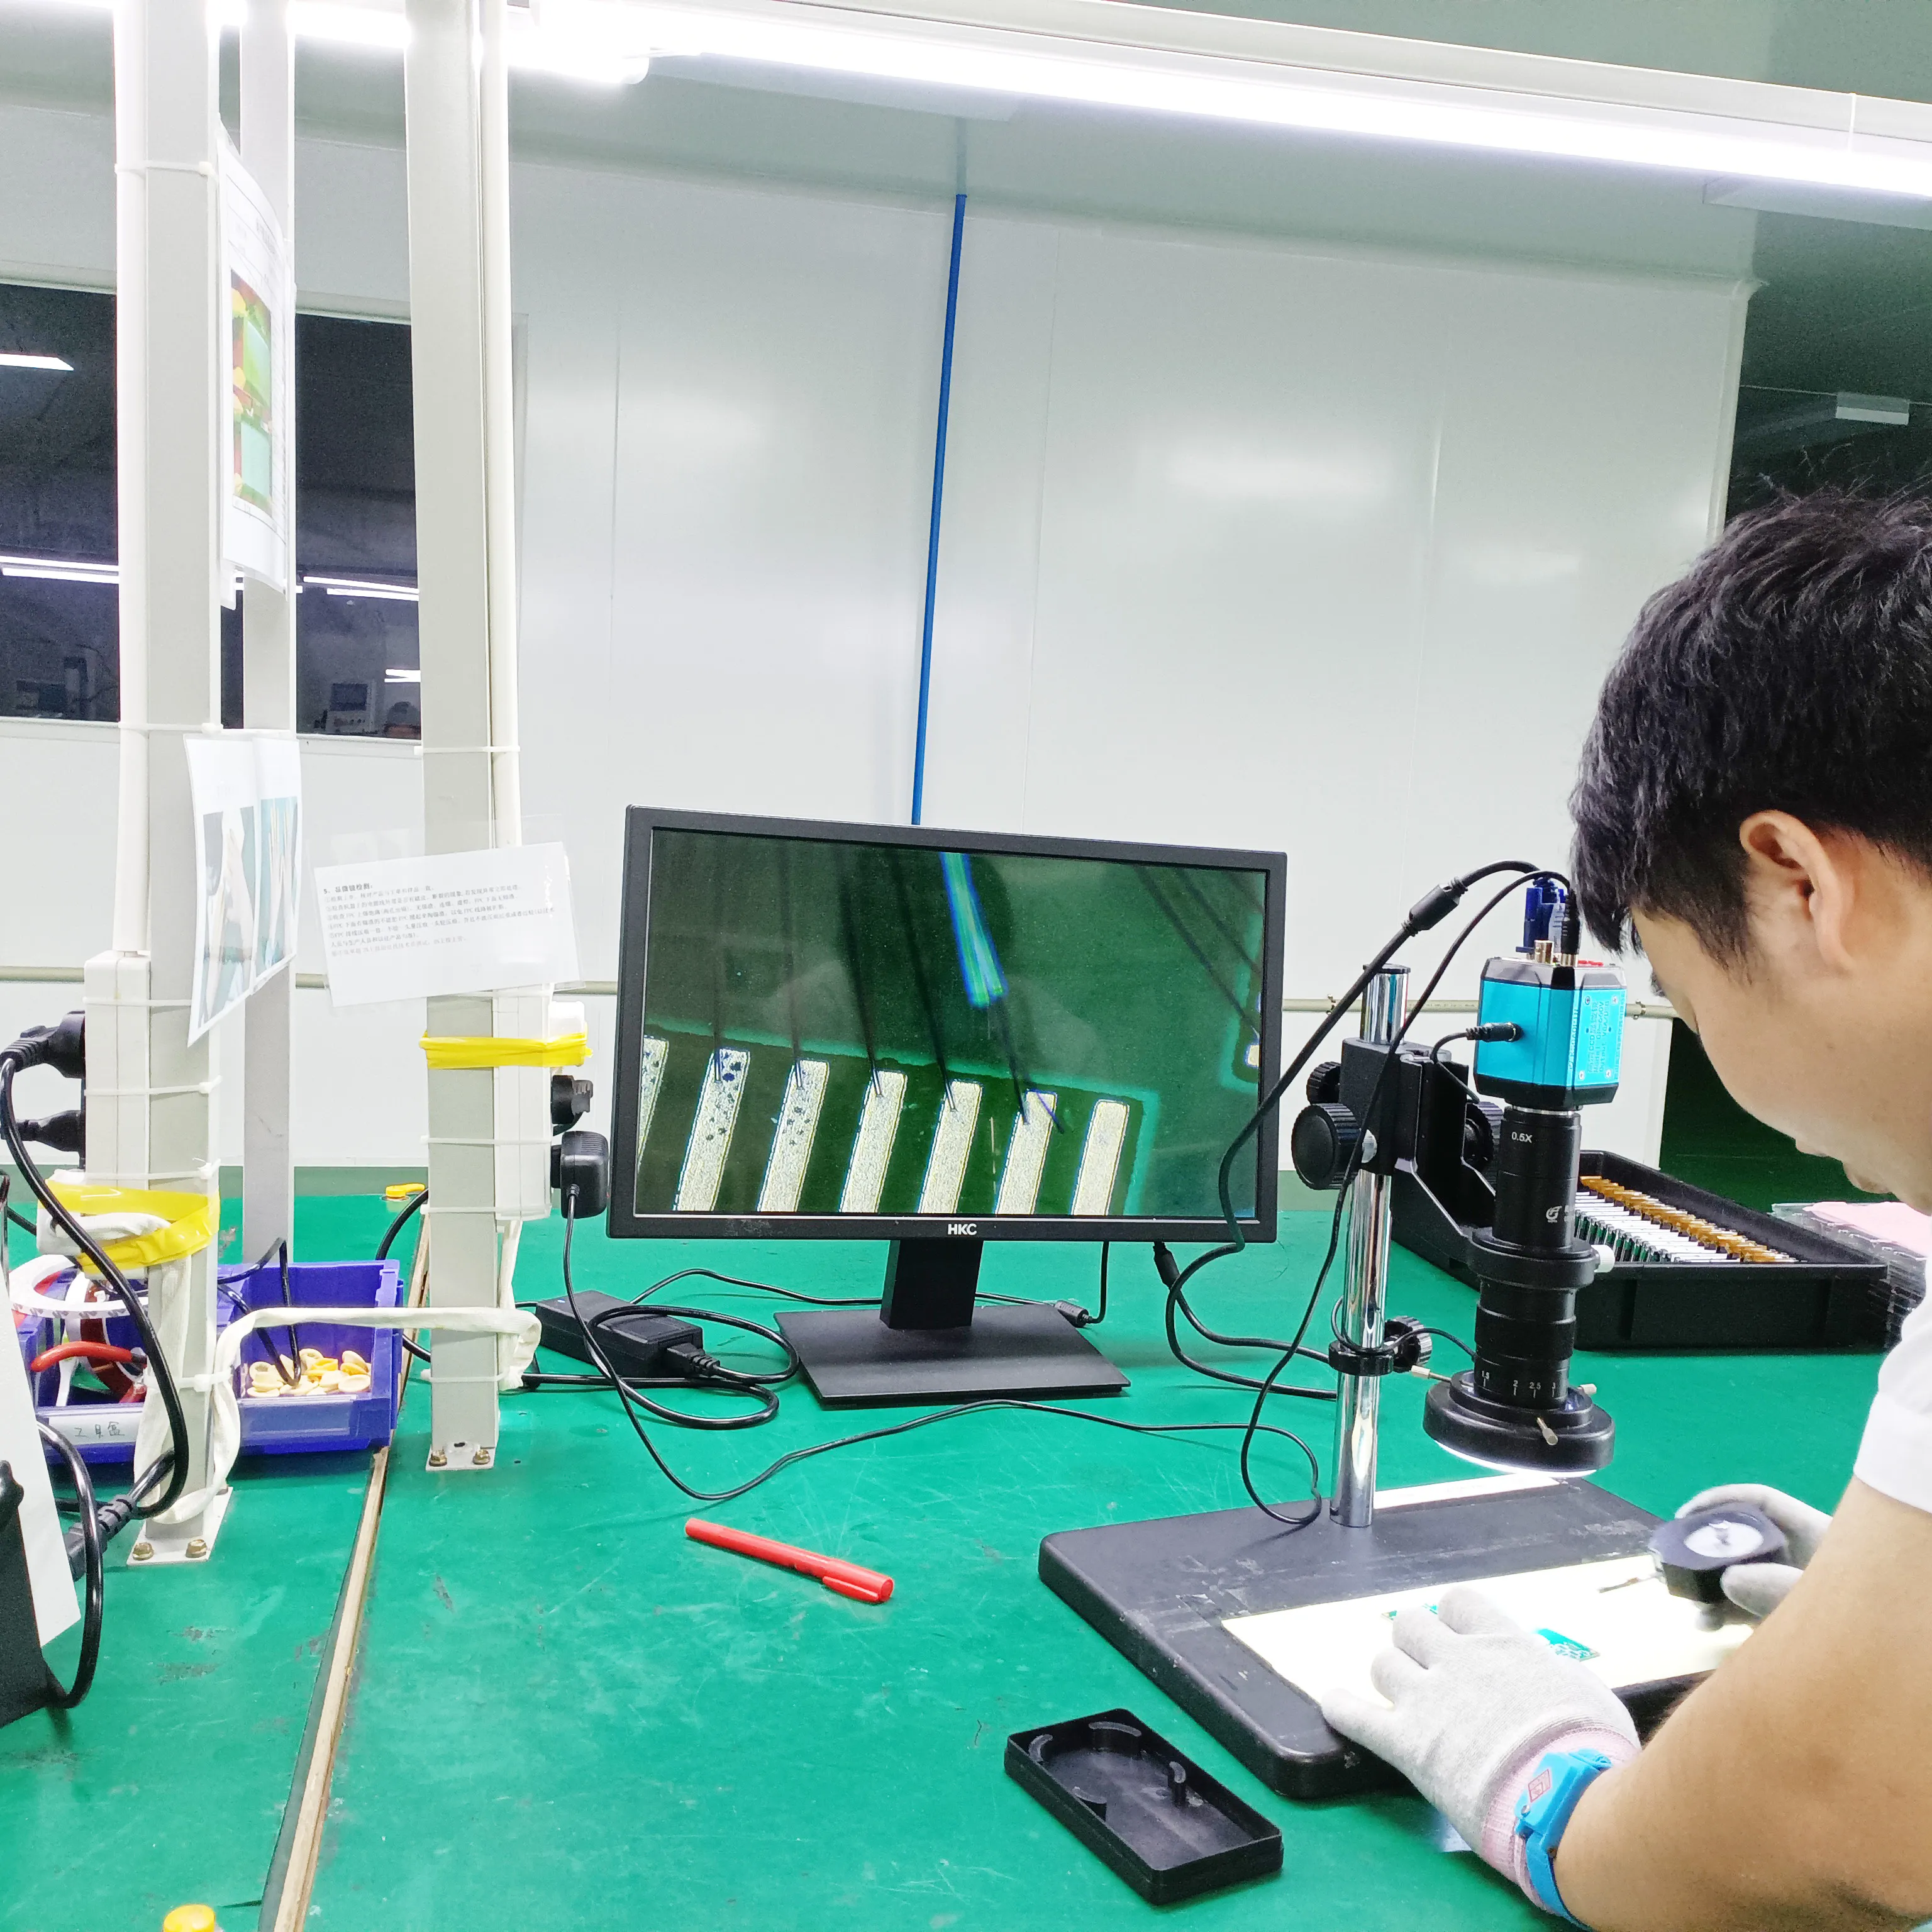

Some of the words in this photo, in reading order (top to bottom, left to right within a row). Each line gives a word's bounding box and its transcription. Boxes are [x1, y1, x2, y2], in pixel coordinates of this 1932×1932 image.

[1511, 1131, 1533, 1143] 0.5X
[948, 1223, 977, 1235] HKC
[1513, 1379, 1518, 1387] 2
